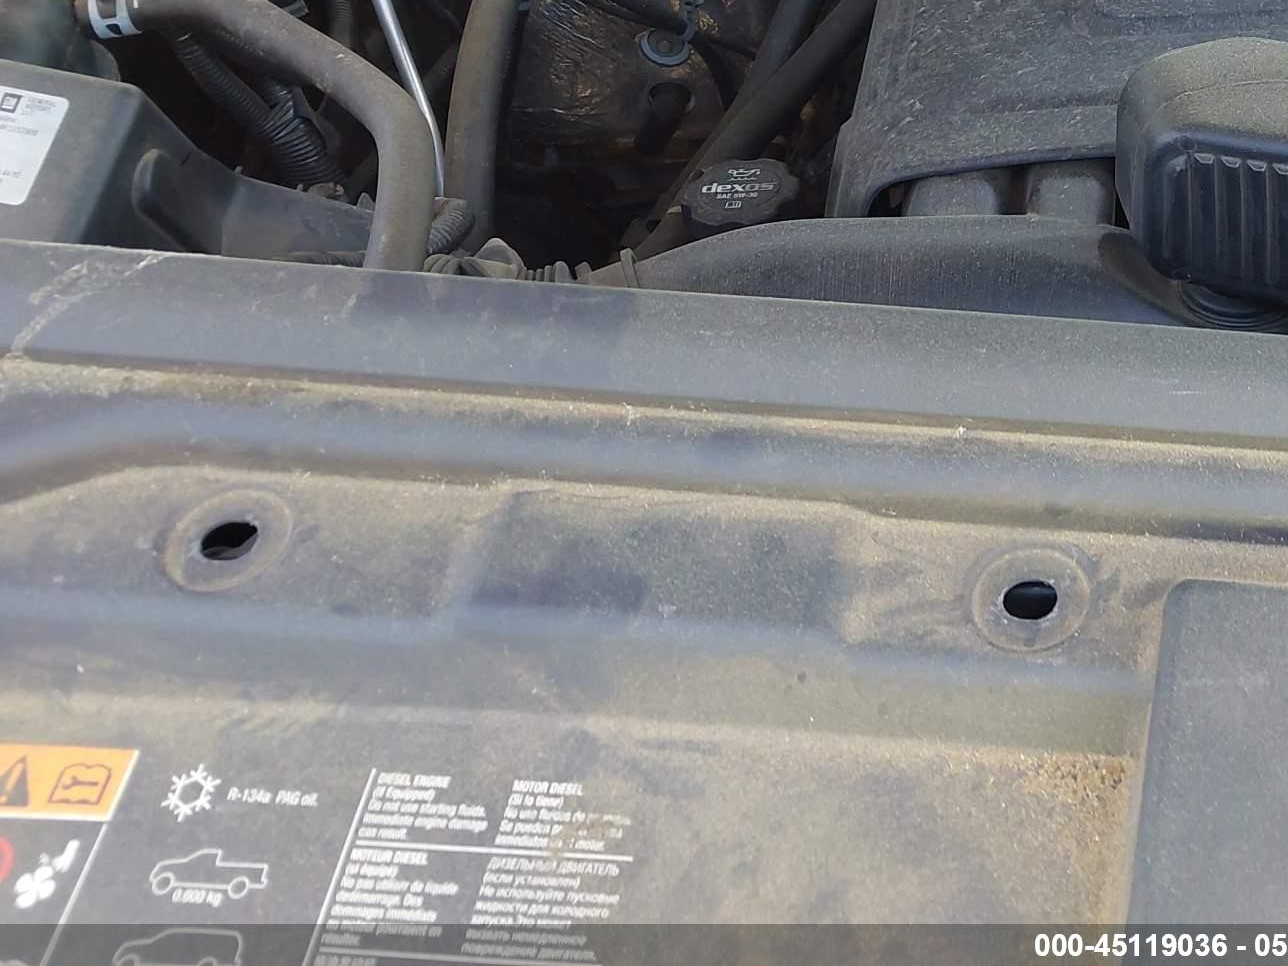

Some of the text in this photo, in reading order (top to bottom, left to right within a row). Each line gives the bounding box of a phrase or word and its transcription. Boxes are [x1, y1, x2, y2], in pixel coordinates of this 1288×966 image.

[702, 182, 777, 194] dexos
[512, 779, 583, 796] MOTOR DIESEL
[226, 787, 271, 803] R-134a
[275, 790, 301, 805] PAG
[393, 850, 428, 866] DIESEL
[557, 862, 621, 877] ДВИГАТЕЛЬ
[206, 889, 223, 907] kg
